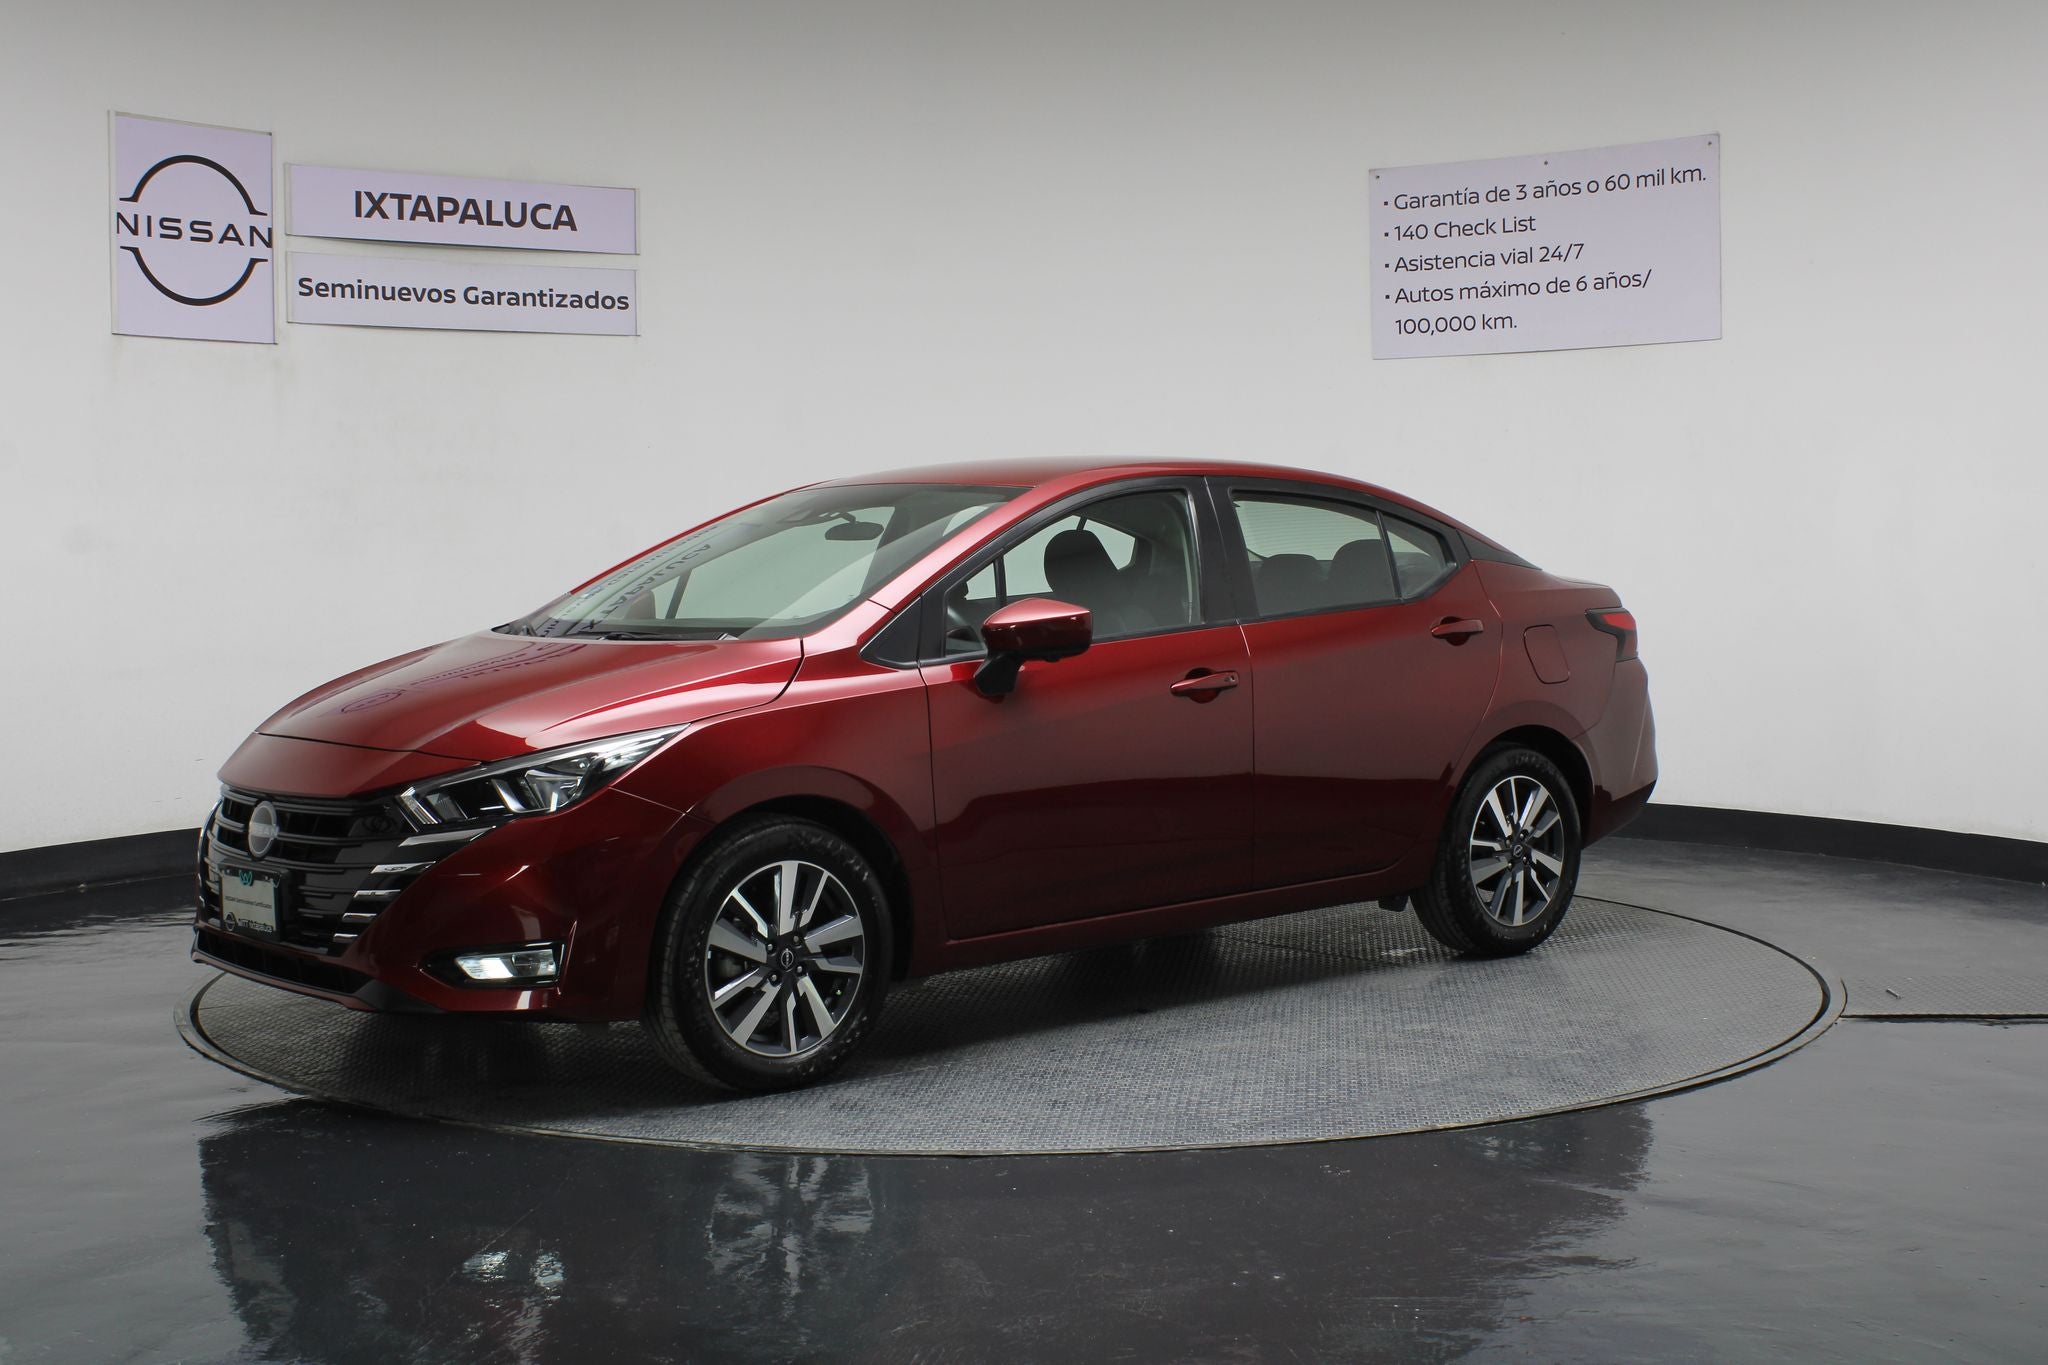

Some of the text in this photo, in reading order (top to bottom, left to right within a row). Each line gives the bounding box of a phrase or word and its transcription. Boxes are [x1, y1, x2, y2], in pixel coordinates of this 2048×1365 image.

[1393, 166, 1706, 210] Garantía de 3 años o 60 mil km.
[354, 190, 578, 232] IXTAPALUCA
[1394, 215, 1537, 241] 140 Check List
[116, 211, 273, 249] NISSAN
[1394, 243, 1585, 273] Asistencia vial 24/7
[298, 277, 630, 311] Seminuevos Garantizados
[1394, 268, 1652, 304] Autos máximo de 6 años/
[1395, 313, 1517, 336] 100,000 km.
